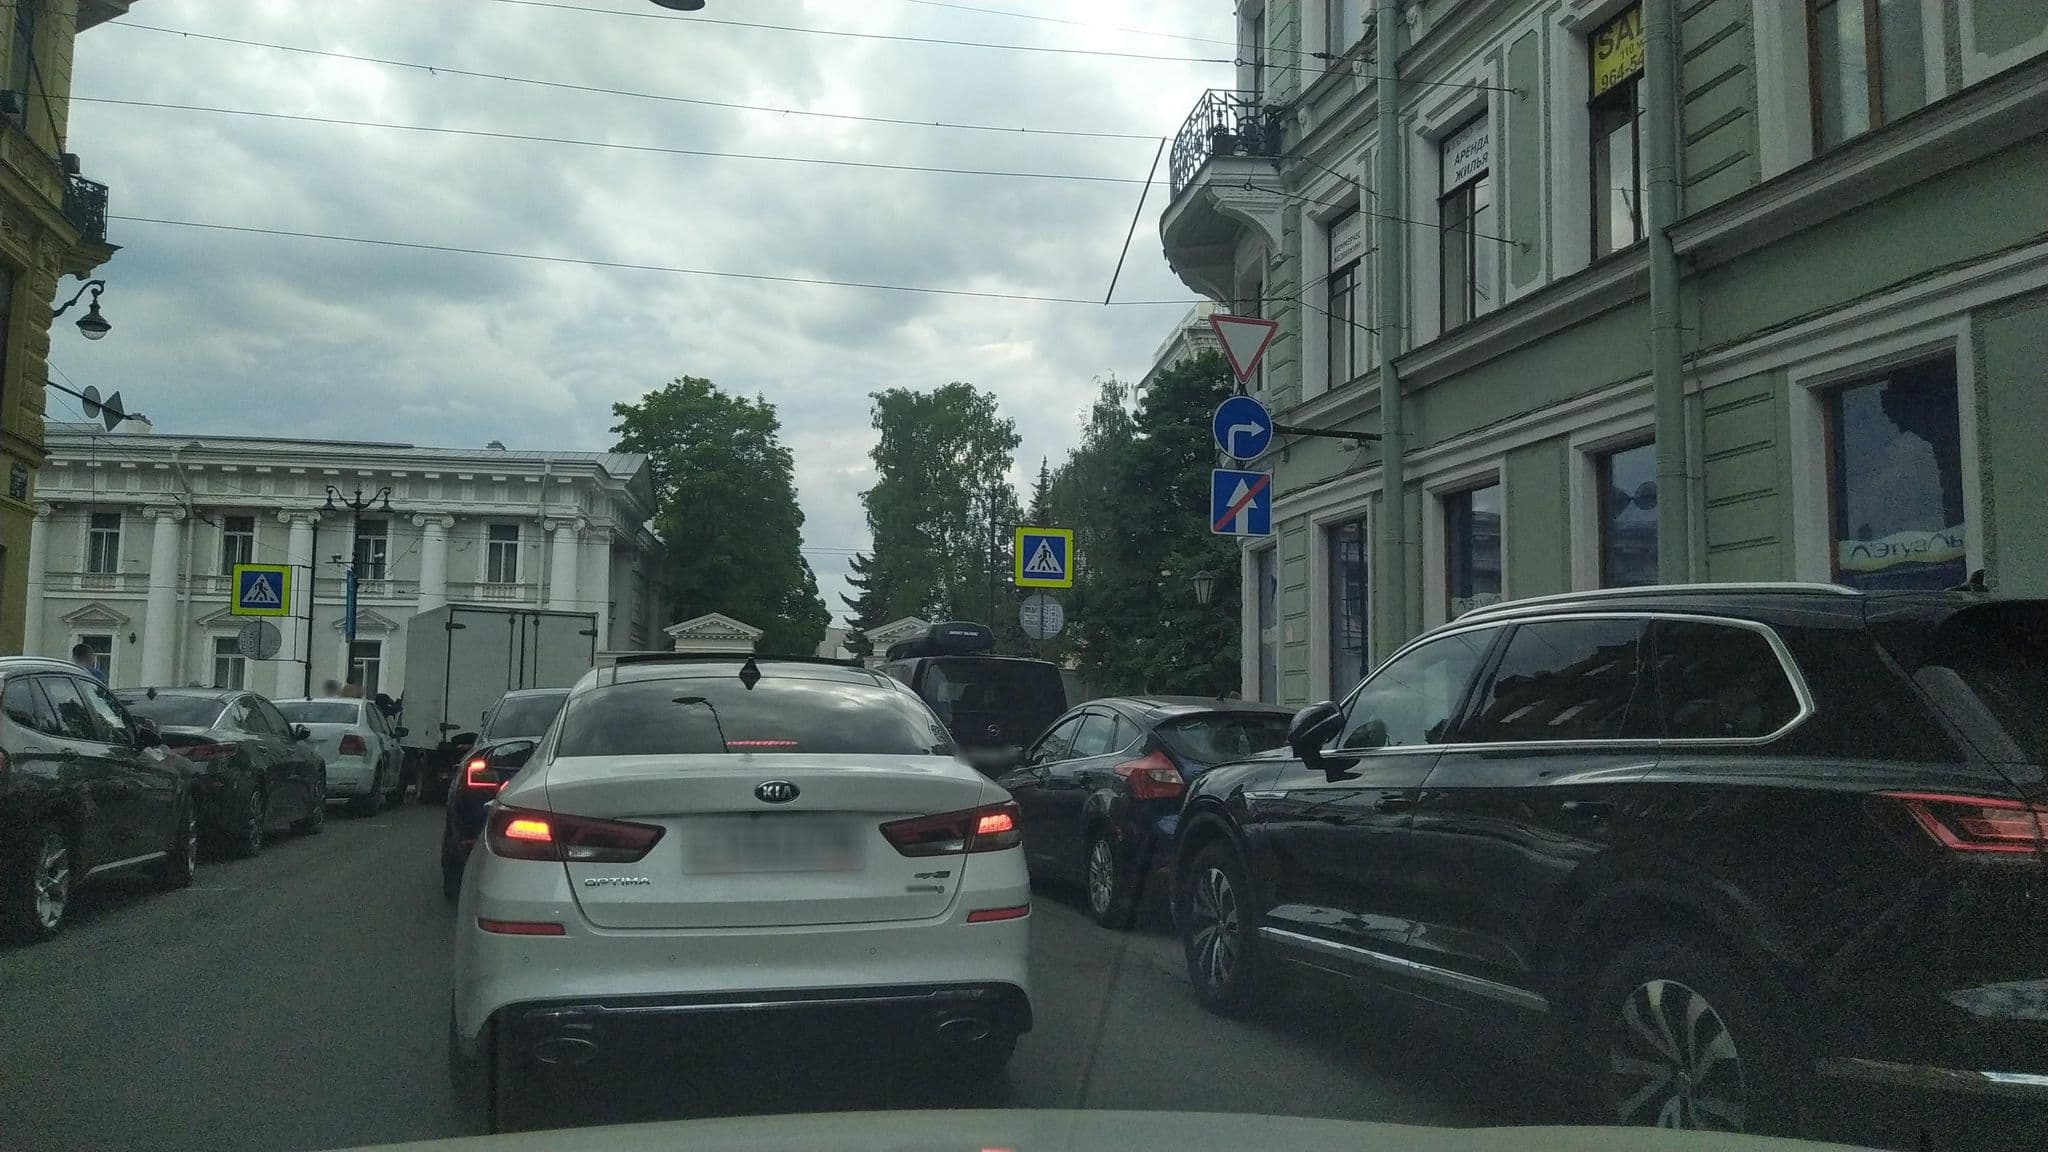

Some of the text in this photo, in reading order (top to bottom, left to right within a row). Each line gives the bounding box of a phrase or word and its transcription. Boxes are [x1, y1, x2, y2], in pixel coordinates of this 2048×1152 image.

[1454, 134, 1489, 167] АРЕНДА
[1455, 151, 1489, 183] ЖИЛЬЯ
[762, 785, 791, 799] KIA
[584, 877, 650, 887] OPTIMA
